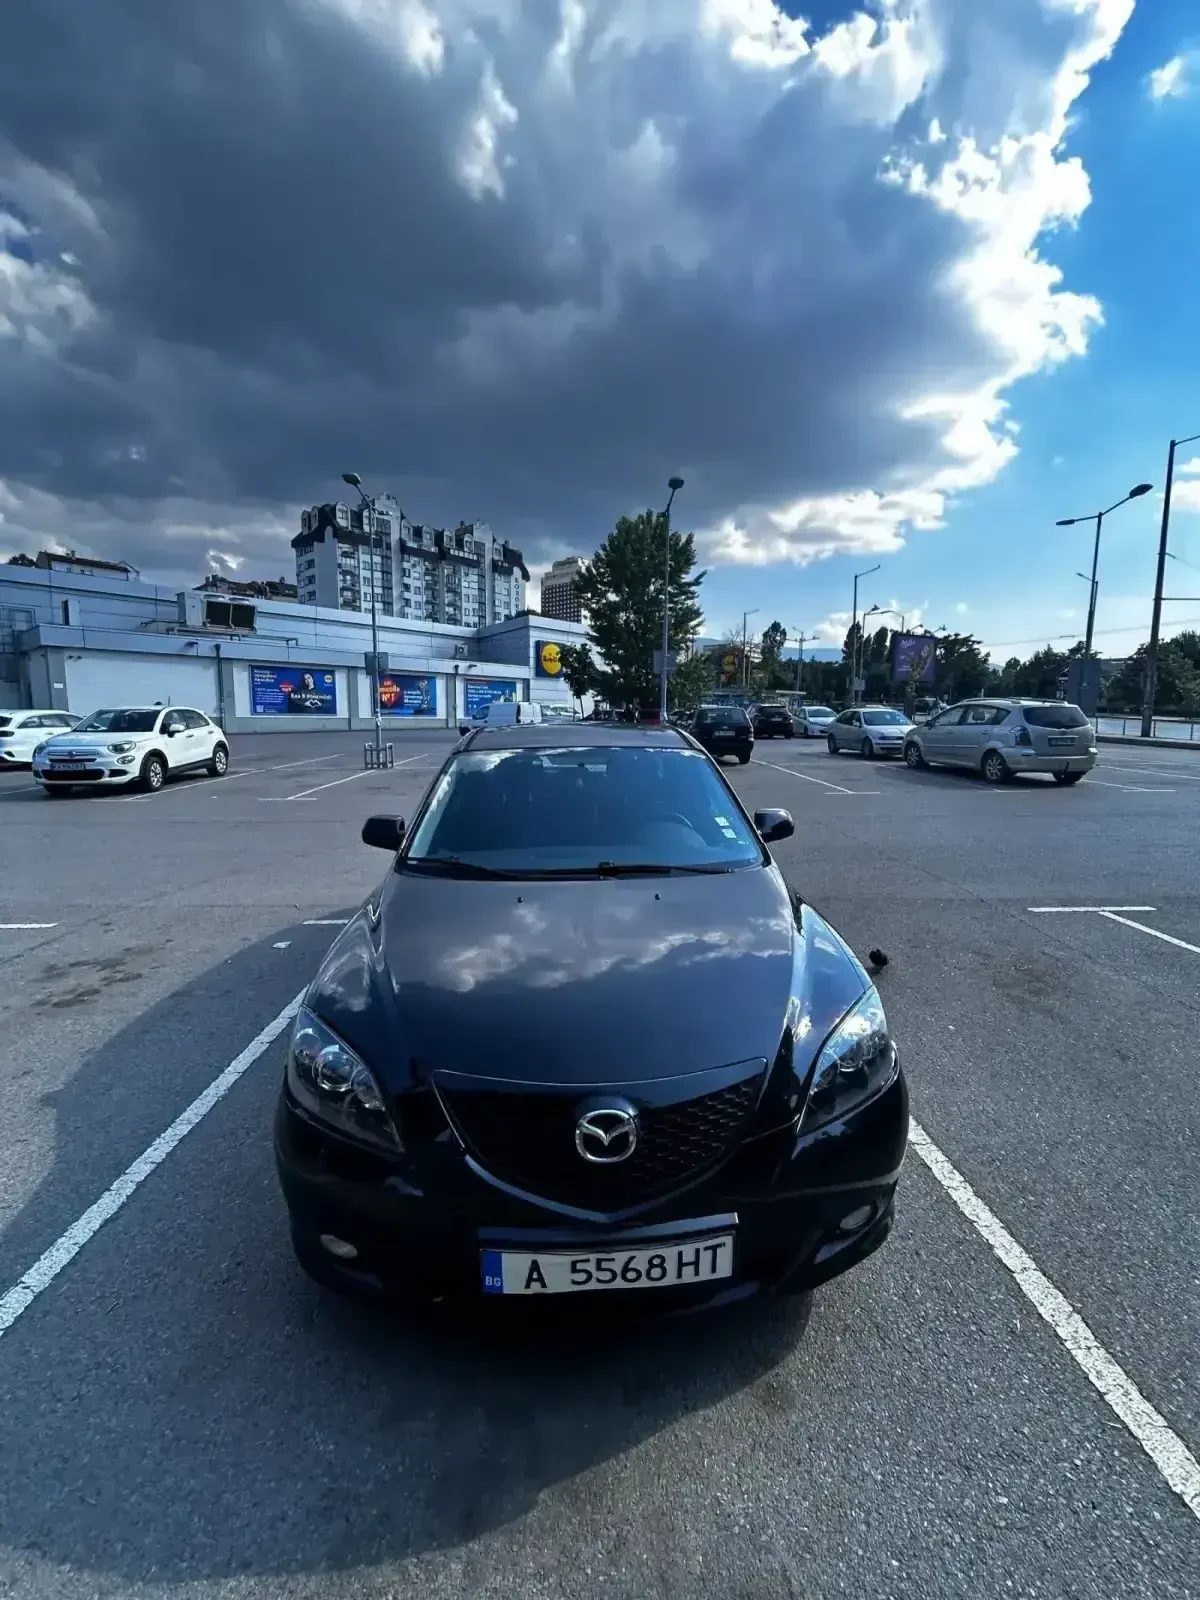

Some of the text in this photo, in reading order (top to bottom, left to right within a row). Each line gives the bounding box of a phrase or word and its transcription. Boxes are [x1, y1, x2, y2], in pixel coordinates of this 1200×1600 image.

[524, 1242, 726, 1289] A 5568 HT
[485, 1276, 501, 1287] BG
